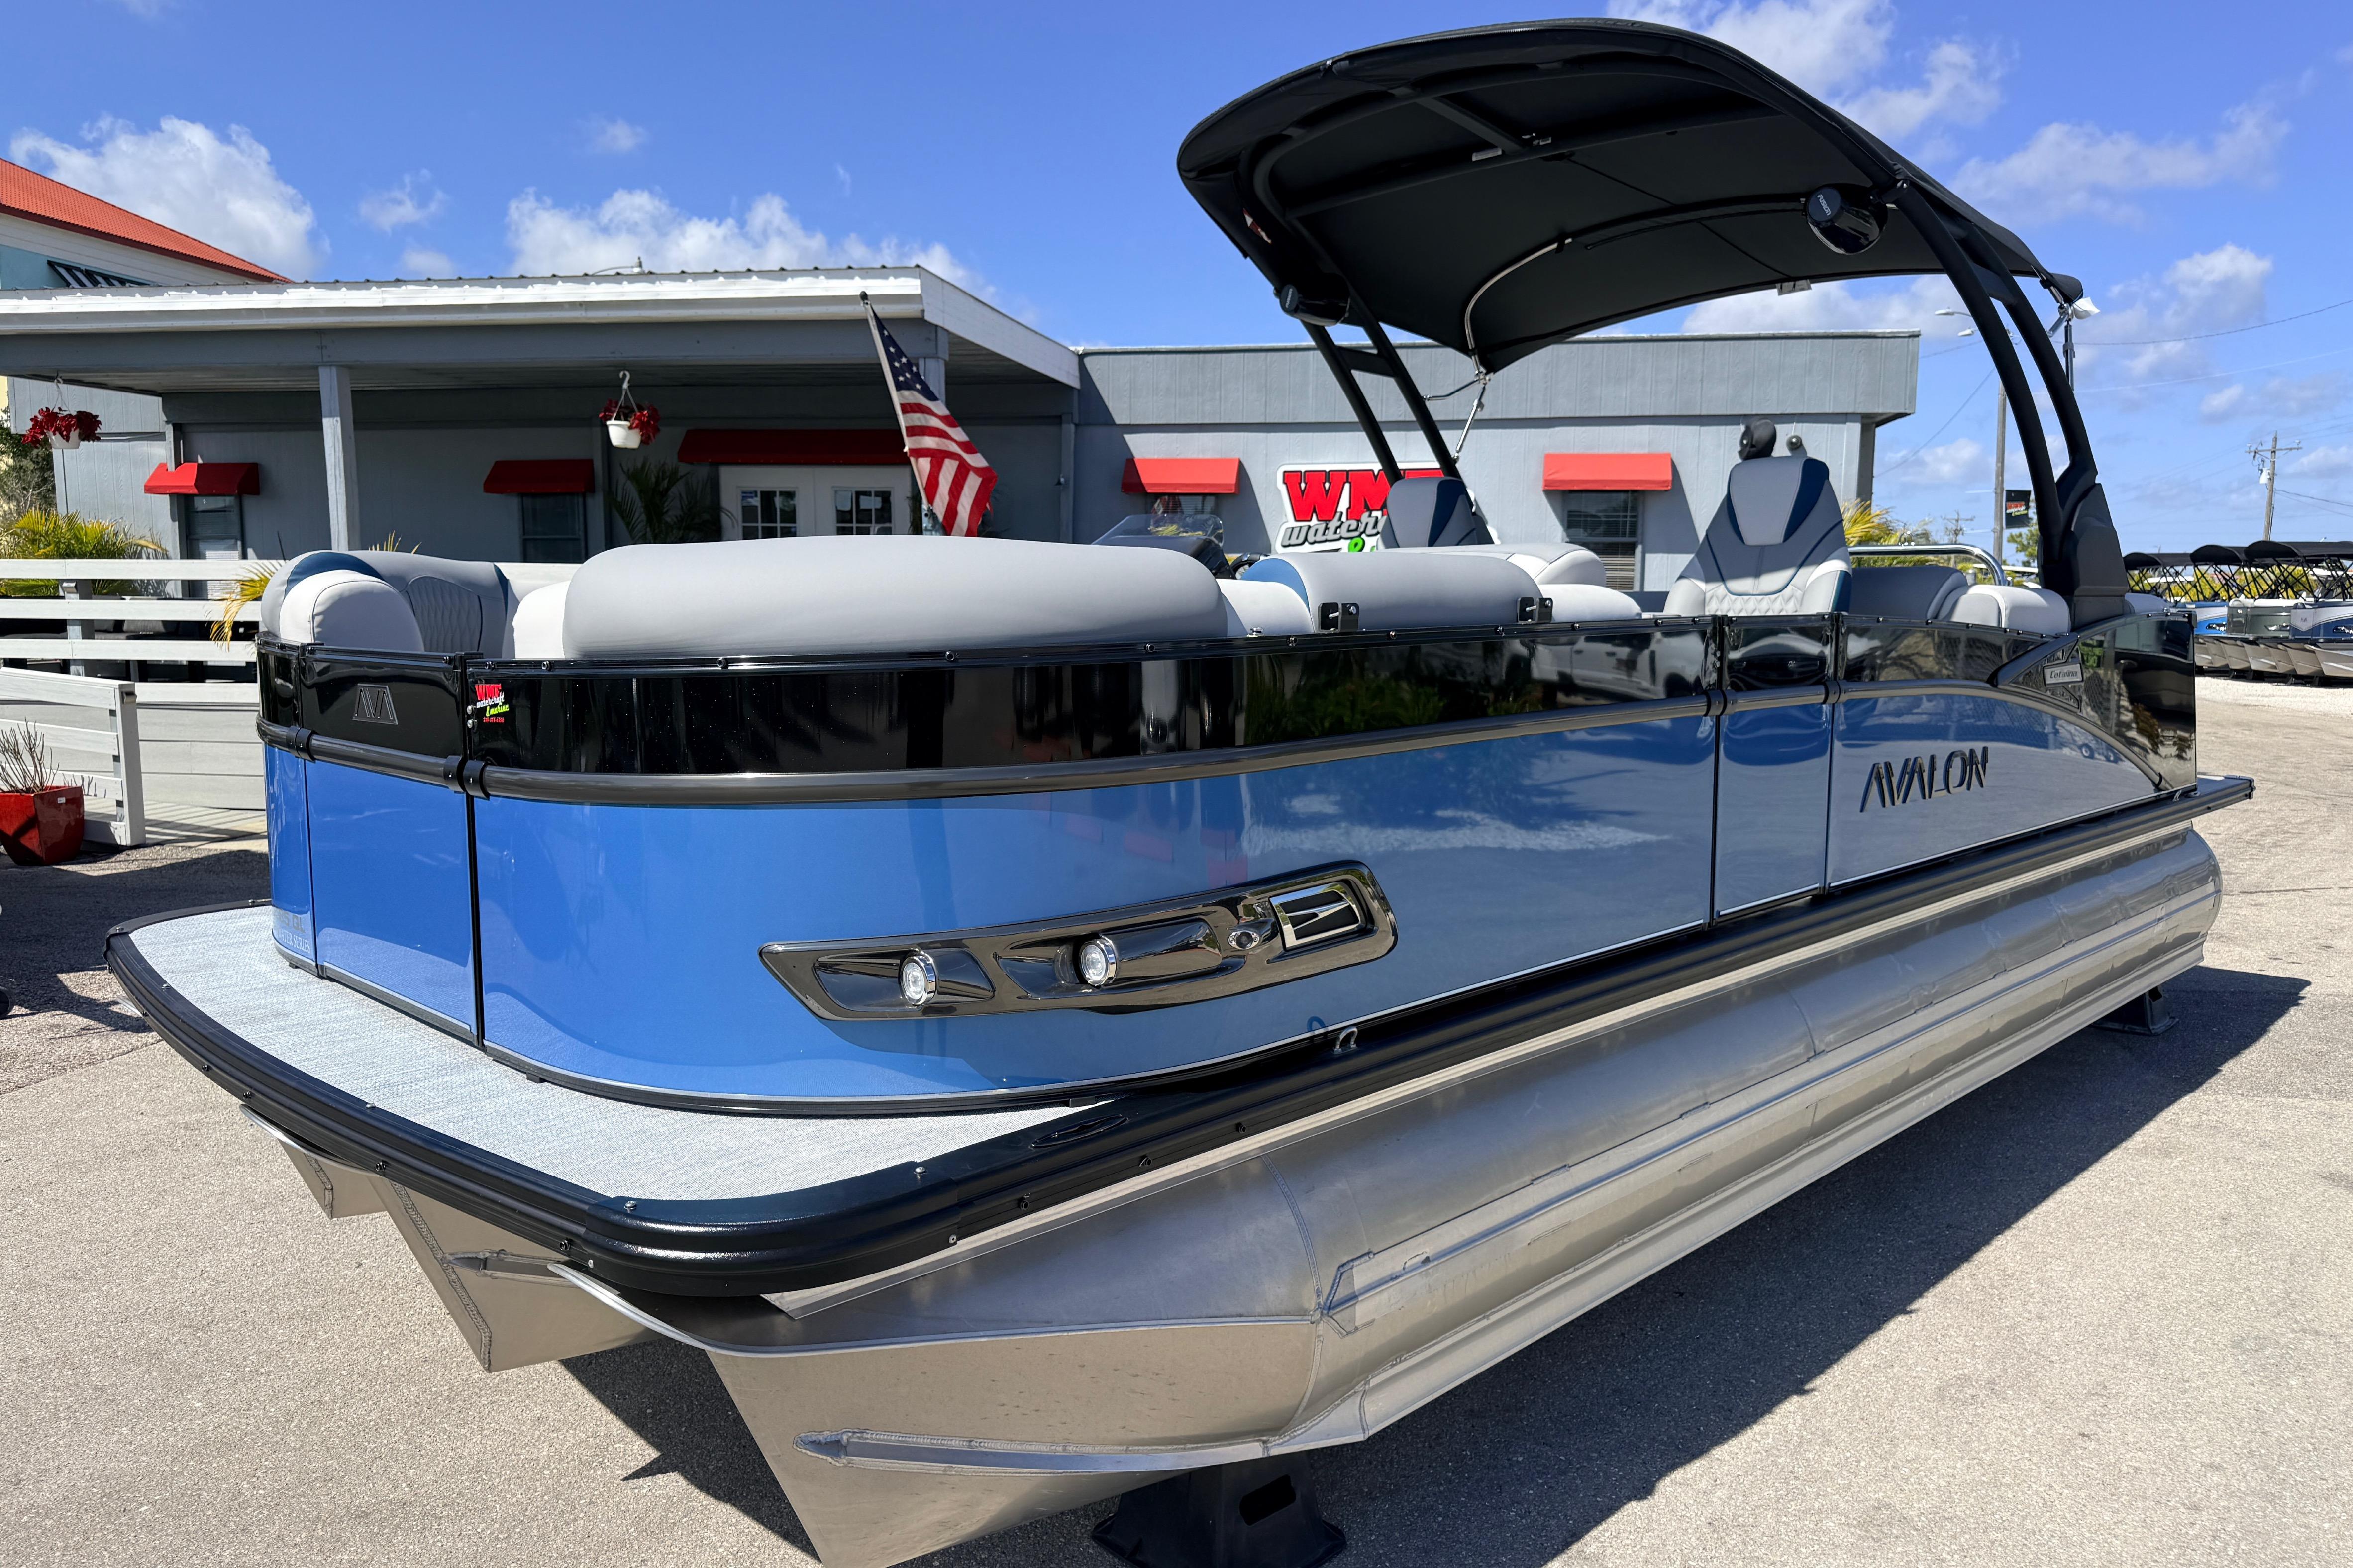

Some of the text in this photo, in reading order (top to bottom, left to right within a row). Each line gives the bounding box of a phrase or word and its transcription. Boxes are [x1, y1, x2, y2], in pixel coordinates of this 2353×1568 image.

[1283, 469, 1444, 521] WM
[2050, 670, 2078, 679] Catalina
[1859, 746, 1989, 813] AVALON
